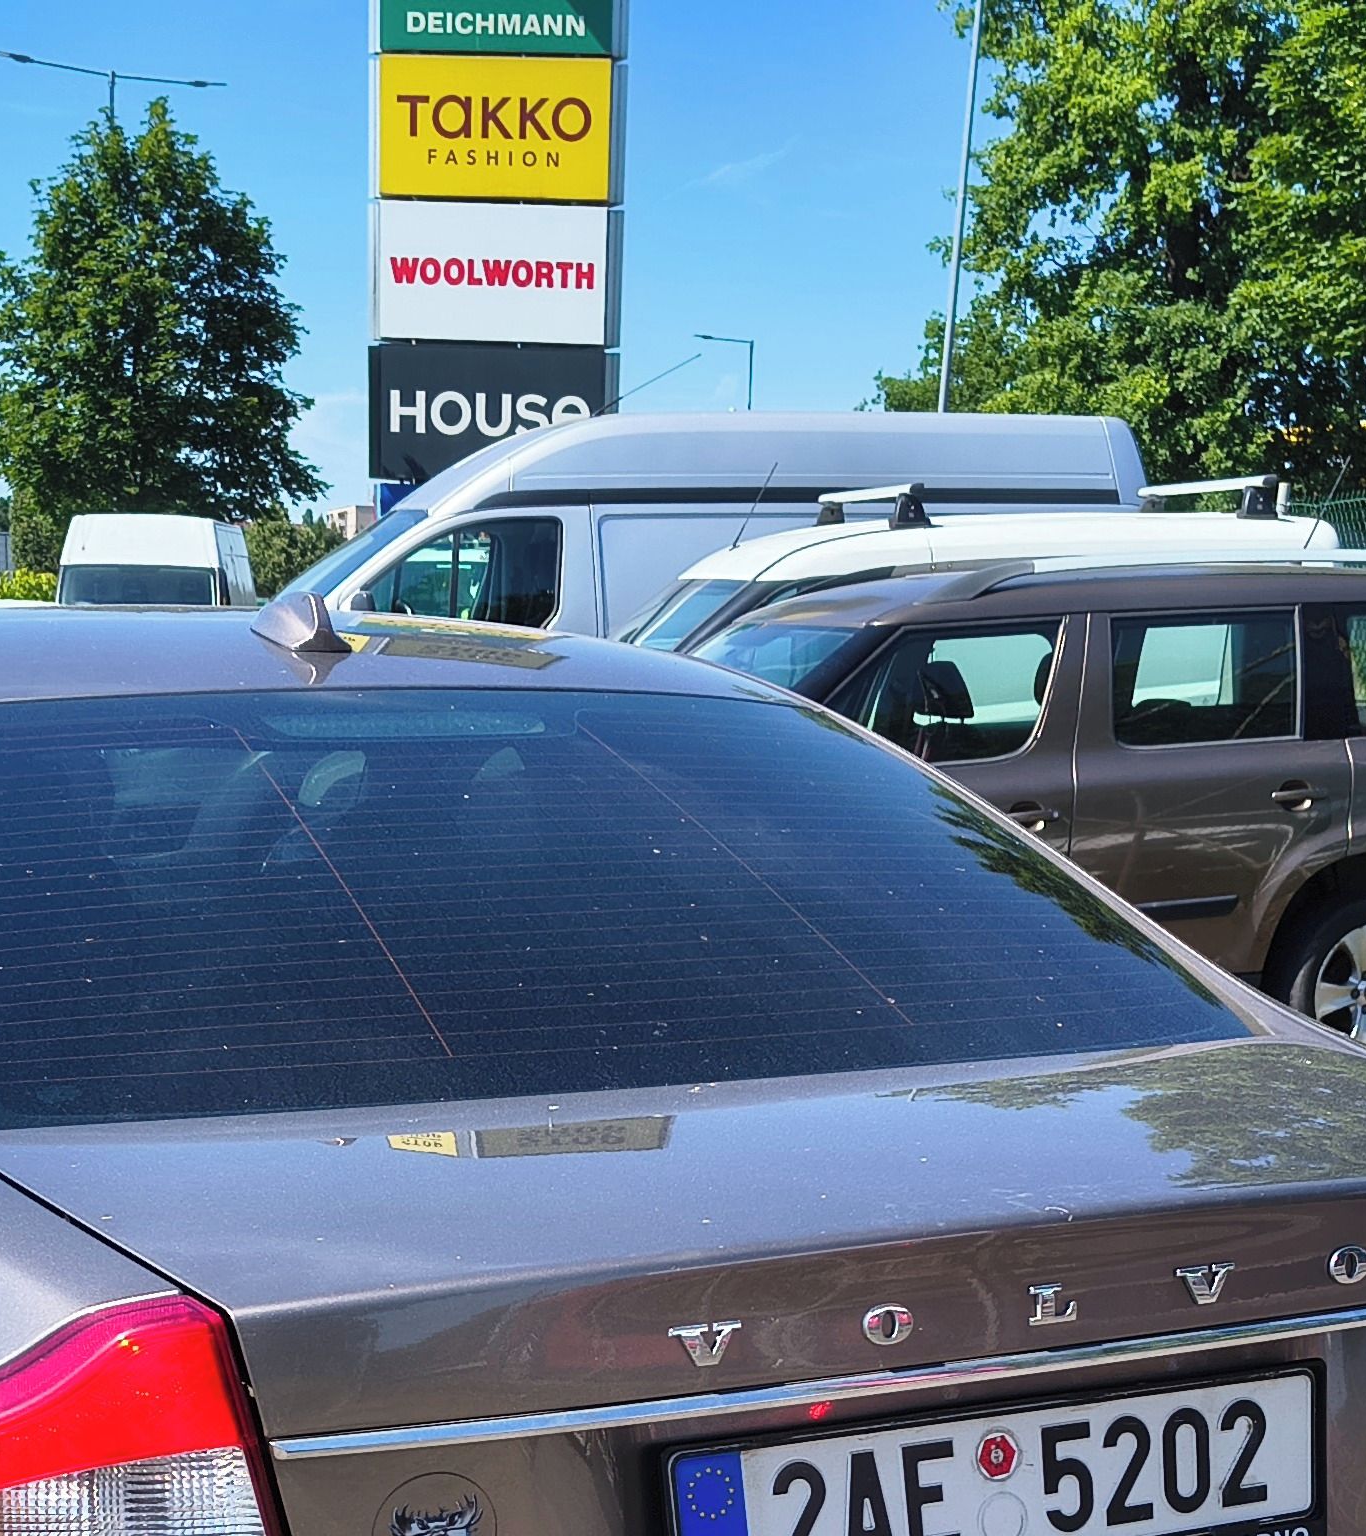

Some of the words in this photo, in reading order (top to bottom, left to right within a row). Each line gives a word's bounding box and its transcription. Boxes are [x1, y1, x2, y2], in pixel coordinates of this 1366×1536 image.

[406, 11, 586, 37] DEICHMANN
[427, 148, 561, 168] FASHION
[390, 256, 595, 290] WOOLWORTH
[1040, 1399, 1269, 1534] 5202
